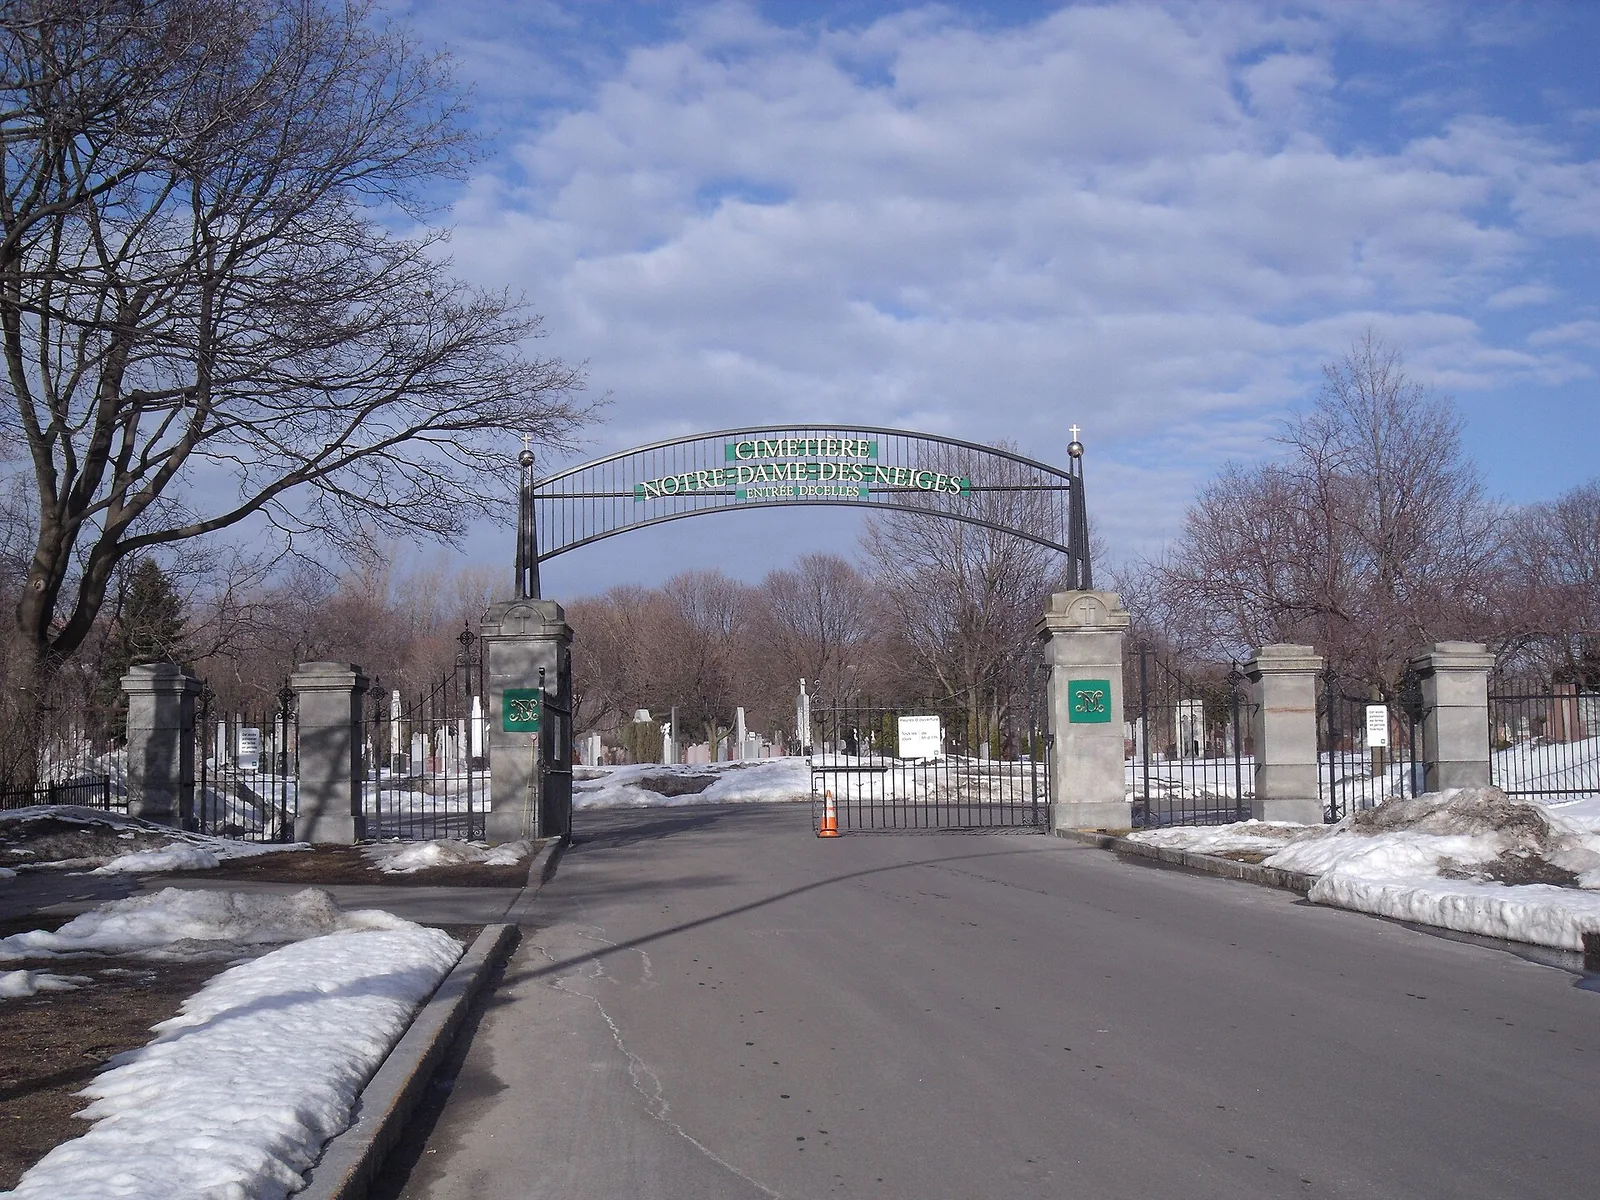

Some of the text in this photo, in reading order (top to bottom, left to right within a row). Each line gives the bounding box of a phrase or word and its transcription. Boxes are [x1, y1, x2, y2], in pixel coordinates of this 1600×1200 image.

[735, 434, 870, 460] CIMETIÈRE
[640, 461, 962, 500] NOTRE-DAME-DES-NEIGES
[746, 485, 860, 499] ENTRÉE DECELLES
